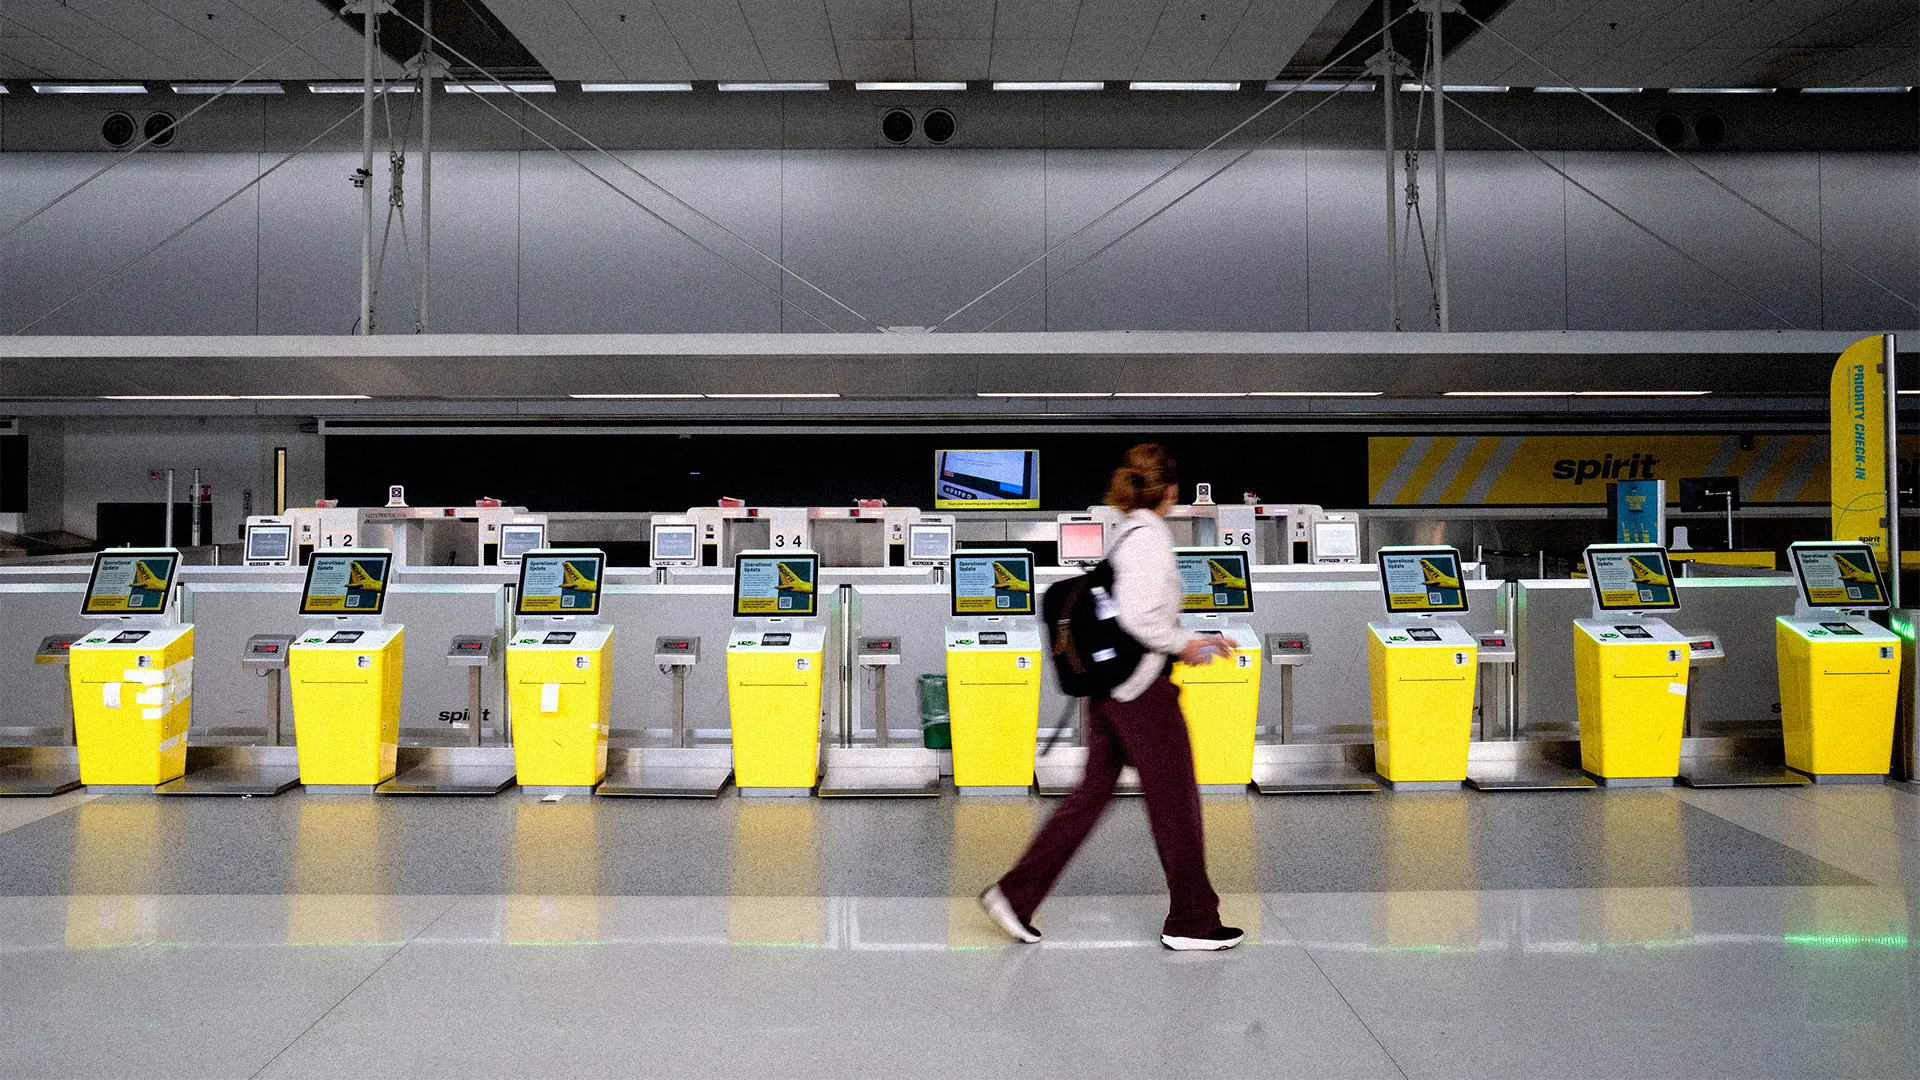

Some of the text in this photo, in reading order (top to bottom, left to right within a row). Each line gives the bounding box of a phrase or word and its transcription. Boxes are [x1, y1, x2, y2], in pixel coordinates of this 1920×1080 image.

[1853, 364, 1866, 481] PRIORITY CHECK-IN
[1552, 453, 1657, 485] spirit
[326, 534, 353, 547] 1 2
[775, 534, 802, 547] 3 4
[1224, 532, 1251, 545] 5 6
[438, 708, 490, 724] spit
